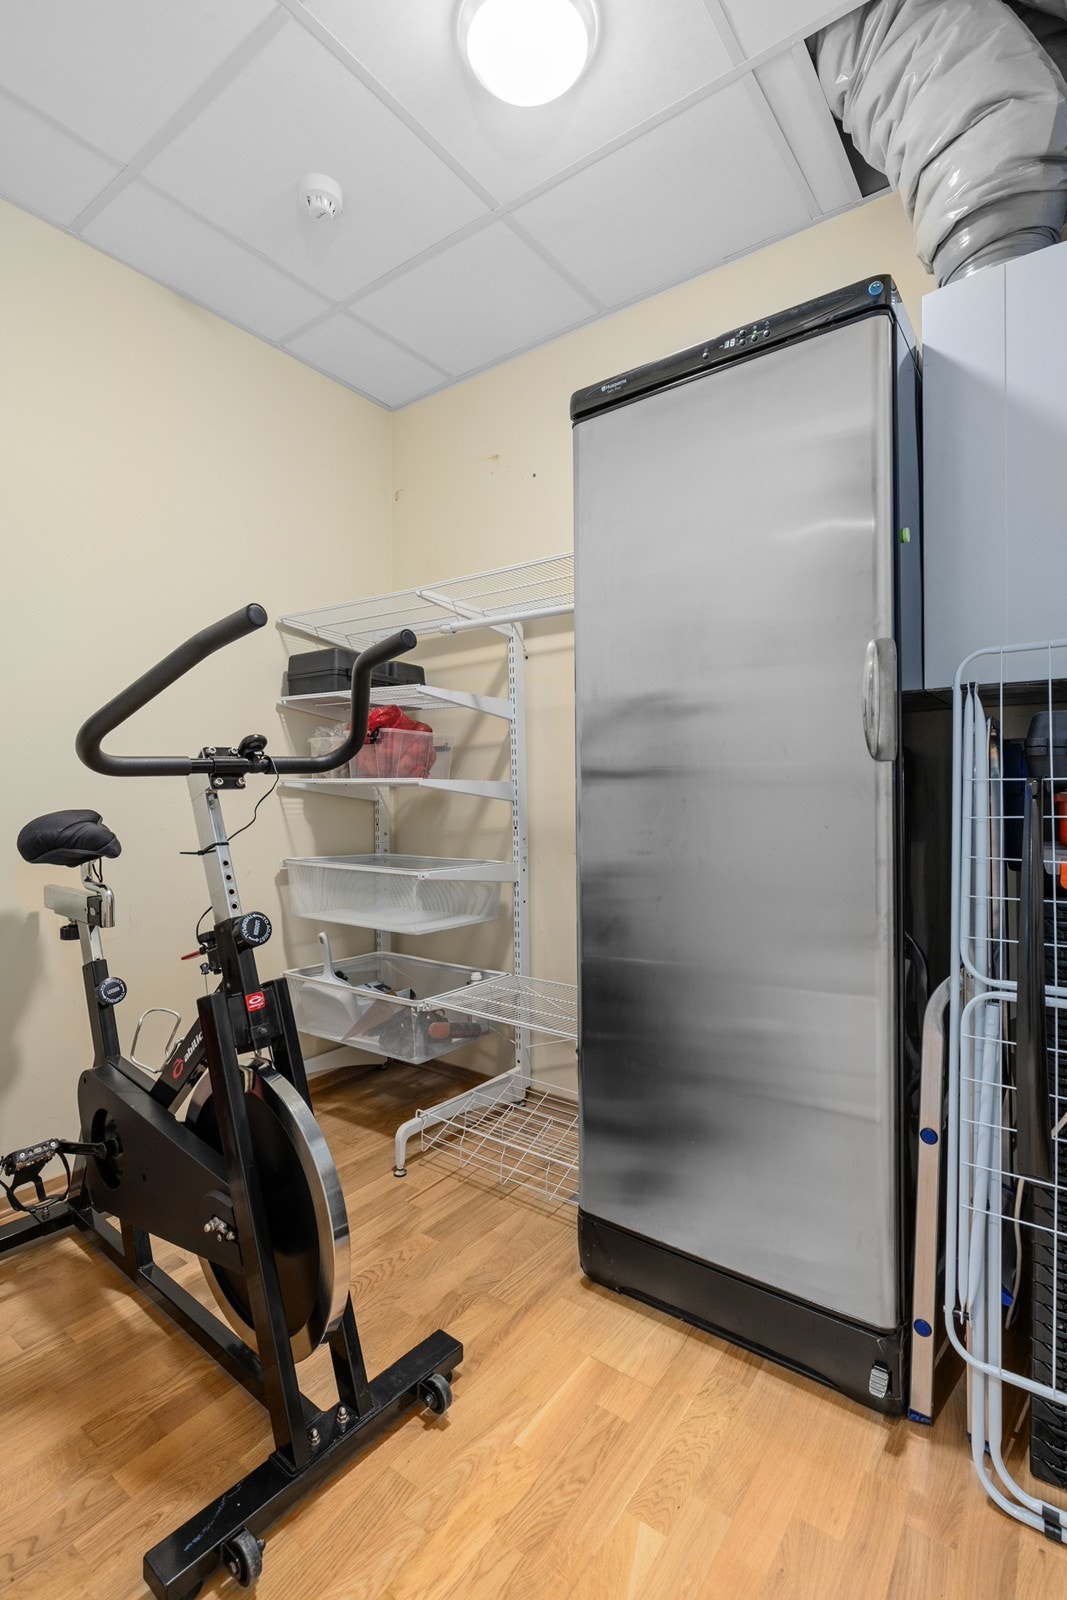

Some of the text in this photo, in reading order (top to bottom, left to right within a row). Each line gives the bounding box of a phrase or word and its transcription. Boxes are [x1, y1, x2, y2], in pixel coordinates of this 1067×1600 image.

[259, 916, 271, 943] TO ADJUST
[183, 1030, 204, 1063] abilic
